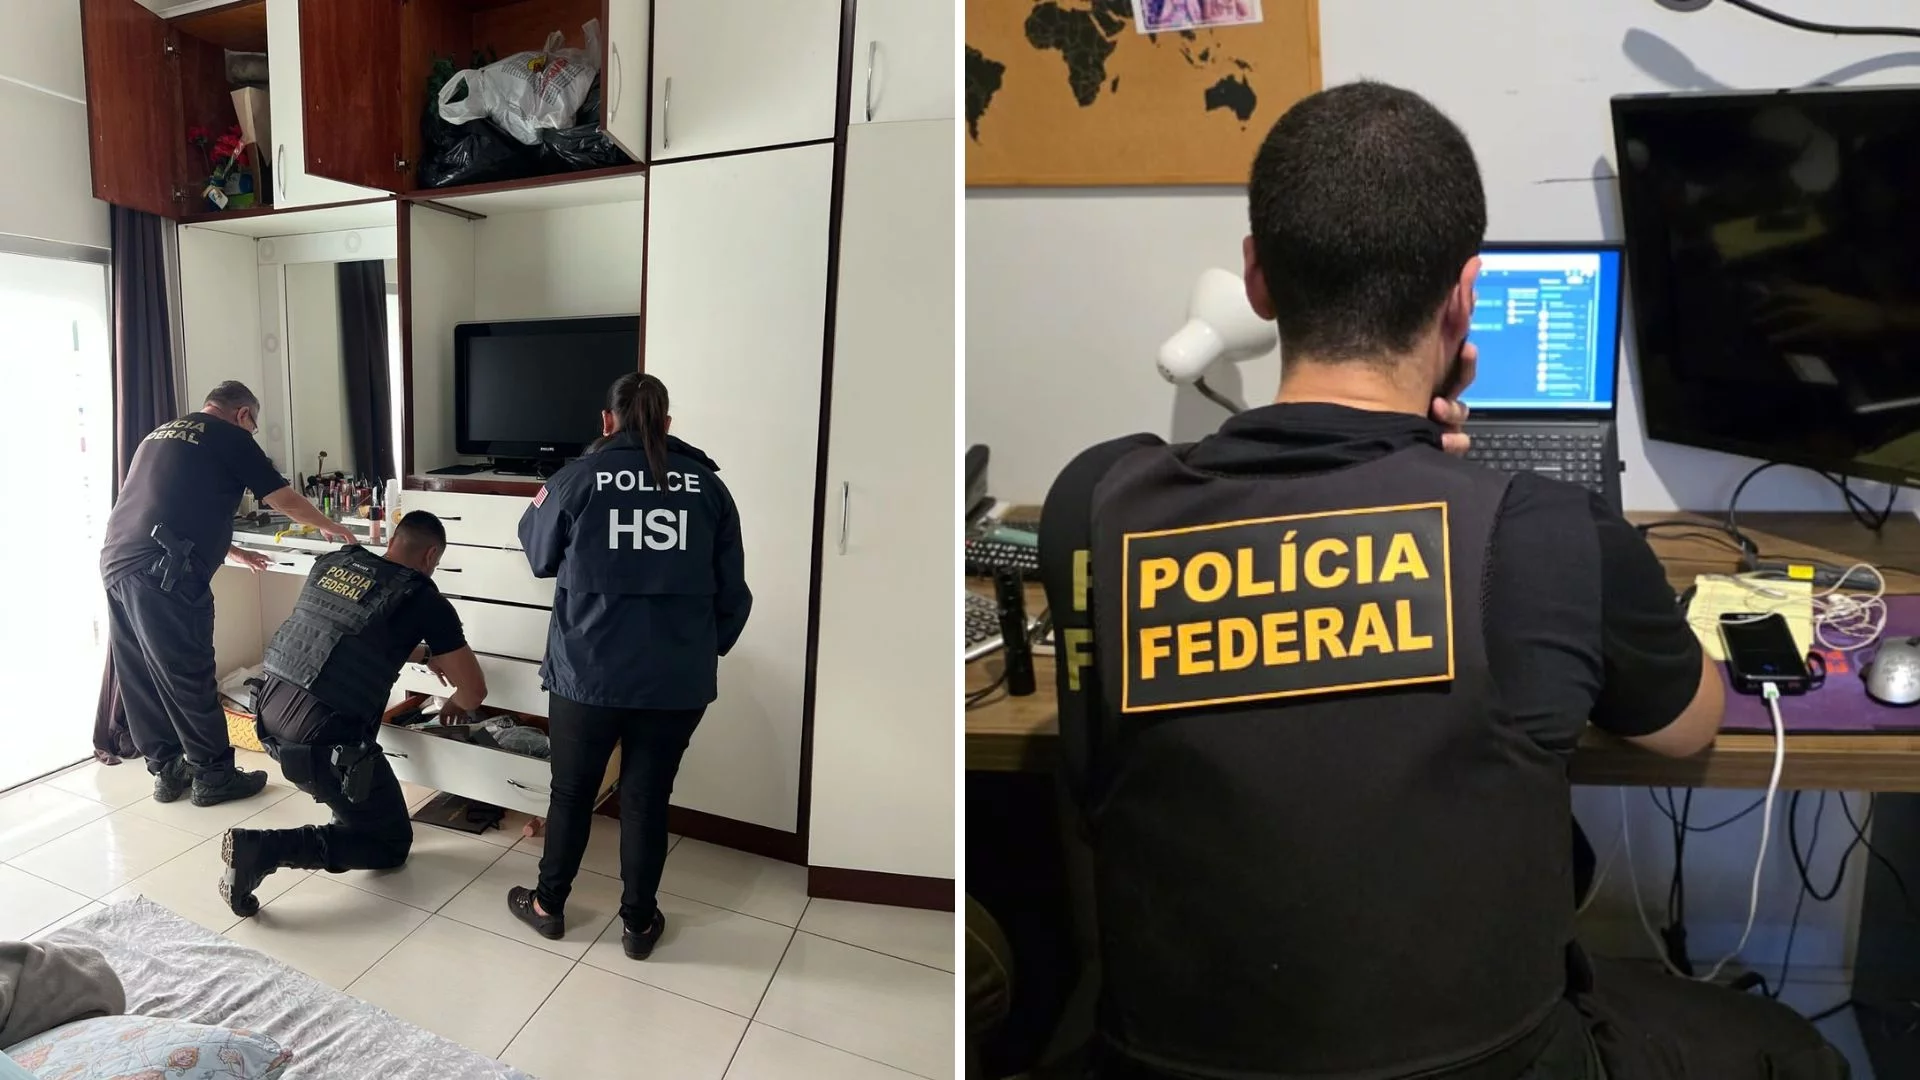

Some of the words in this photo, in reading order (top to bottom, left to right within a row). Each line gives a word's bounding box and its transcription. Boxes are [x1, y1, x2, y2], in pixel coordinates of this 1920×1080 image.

[596, 470, 700, 493] POLCE
[609, 508, 688, 551] HSI
[317, 576, 361, 600] FEDERAL
[1139, 530, 1429, 609] POLÍCIA
[1140, 599, 1433, 679] FEDERAL
